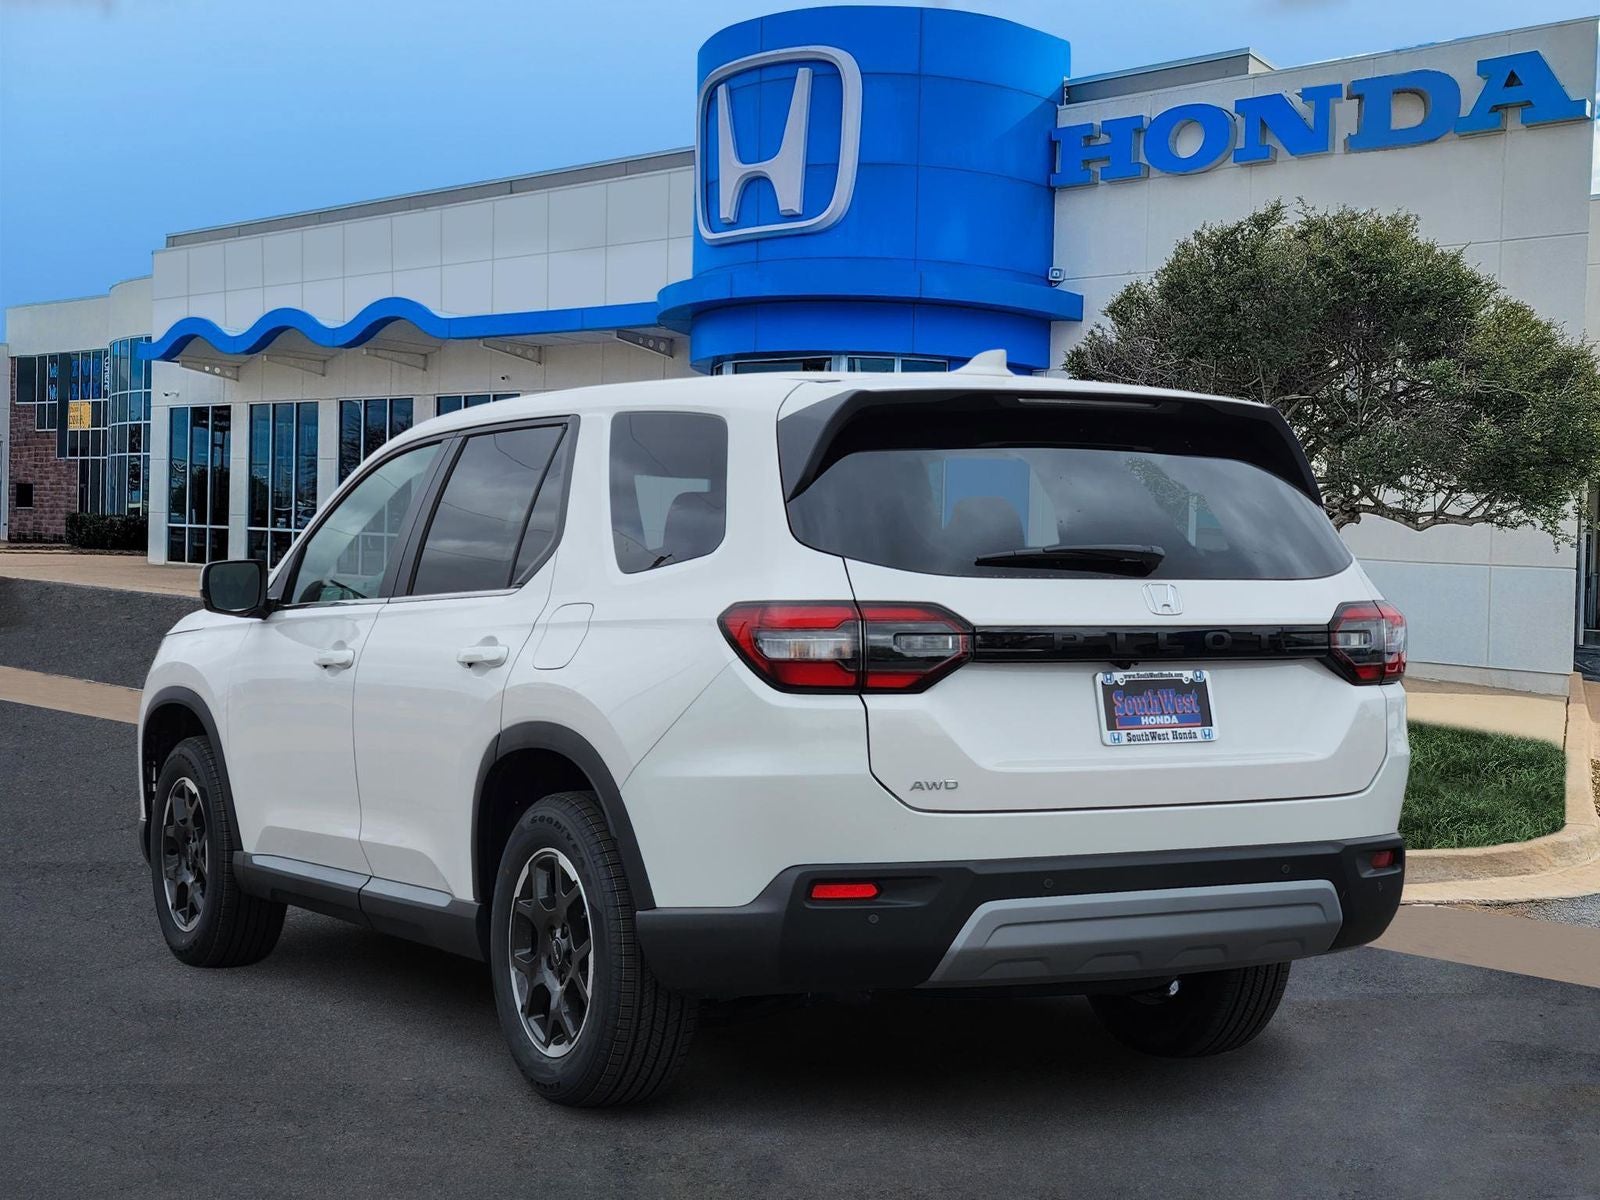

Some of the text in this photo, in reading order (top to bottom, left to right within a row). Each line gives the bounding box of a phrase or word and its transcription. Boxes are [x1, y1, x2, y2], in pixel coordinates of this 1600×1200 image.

[1050, 50, 1591, 188] HONDA
[1054, 630, 1281, 652] PILOT
[1141, 715, 1179, 726] HONDA
[1126, 730, 1198, 743] SouthWest Honda
[910, 780, 959, 791] AWD
